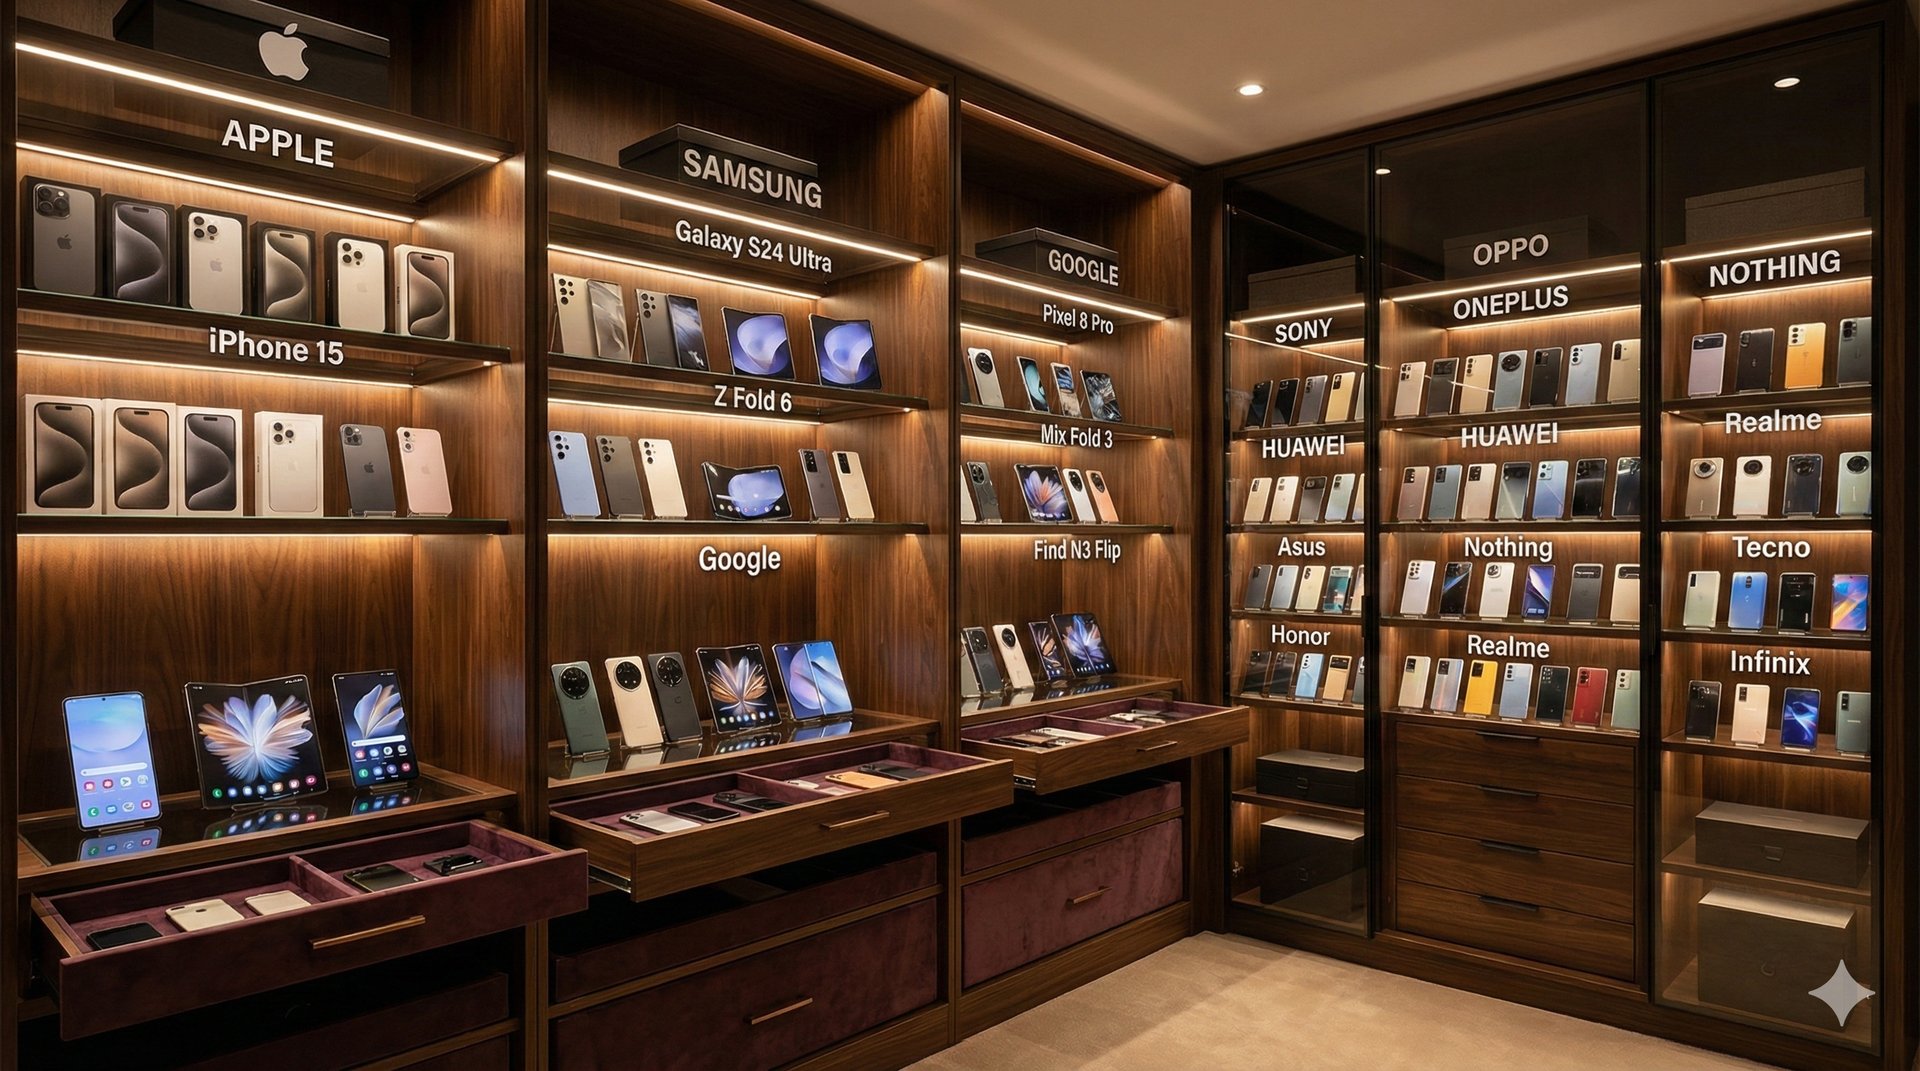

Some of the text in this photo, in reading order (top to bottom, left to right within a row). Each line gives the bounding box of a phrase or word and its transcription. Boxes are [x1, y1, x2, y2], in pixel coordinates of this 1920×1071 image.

[222, 119, 334, 167] APPLE
[683, 148, 821, 210] SAMSUNG
[676, 220, 831, 272] Galaxy S24 Ultra
[1474, 235, 1548, 265] OPPO
[1049, 250, 1118, 286] GOOGLE
[1709, 249, 1841, 287] NOTHING
[1453, 285, 1569, 320] ONEPLUS
[1044, 304, 1113, 334] Pixel 8 Pro
[1276, 318, 1333, 343] SONY
[211, 327, 343, 364] iPhone 15
[715, 385, 791, 412] Z Fold 6
[1725, 410, 1821, 433] Realme
[1041, 424, 1113, 449] Mix Fold 3
[1263, 435, 1344, 458] HUAWEI
[1461, 423, 1558, 447] HUAWEI
[1035, 539, 1120, 563] Find N3 Flip
[1278, 537, 1325, 555] Asus
[1465, 536, 1552, 562] Nothing
[1732, 536, 1810, 557] Tecno
[699, 545, 780, 575] Google
[1272, 625, 1330, 645] Honor
[1469, 635, 1549, 658] Realme
[1732, 650, 1810, 674] Infinix
